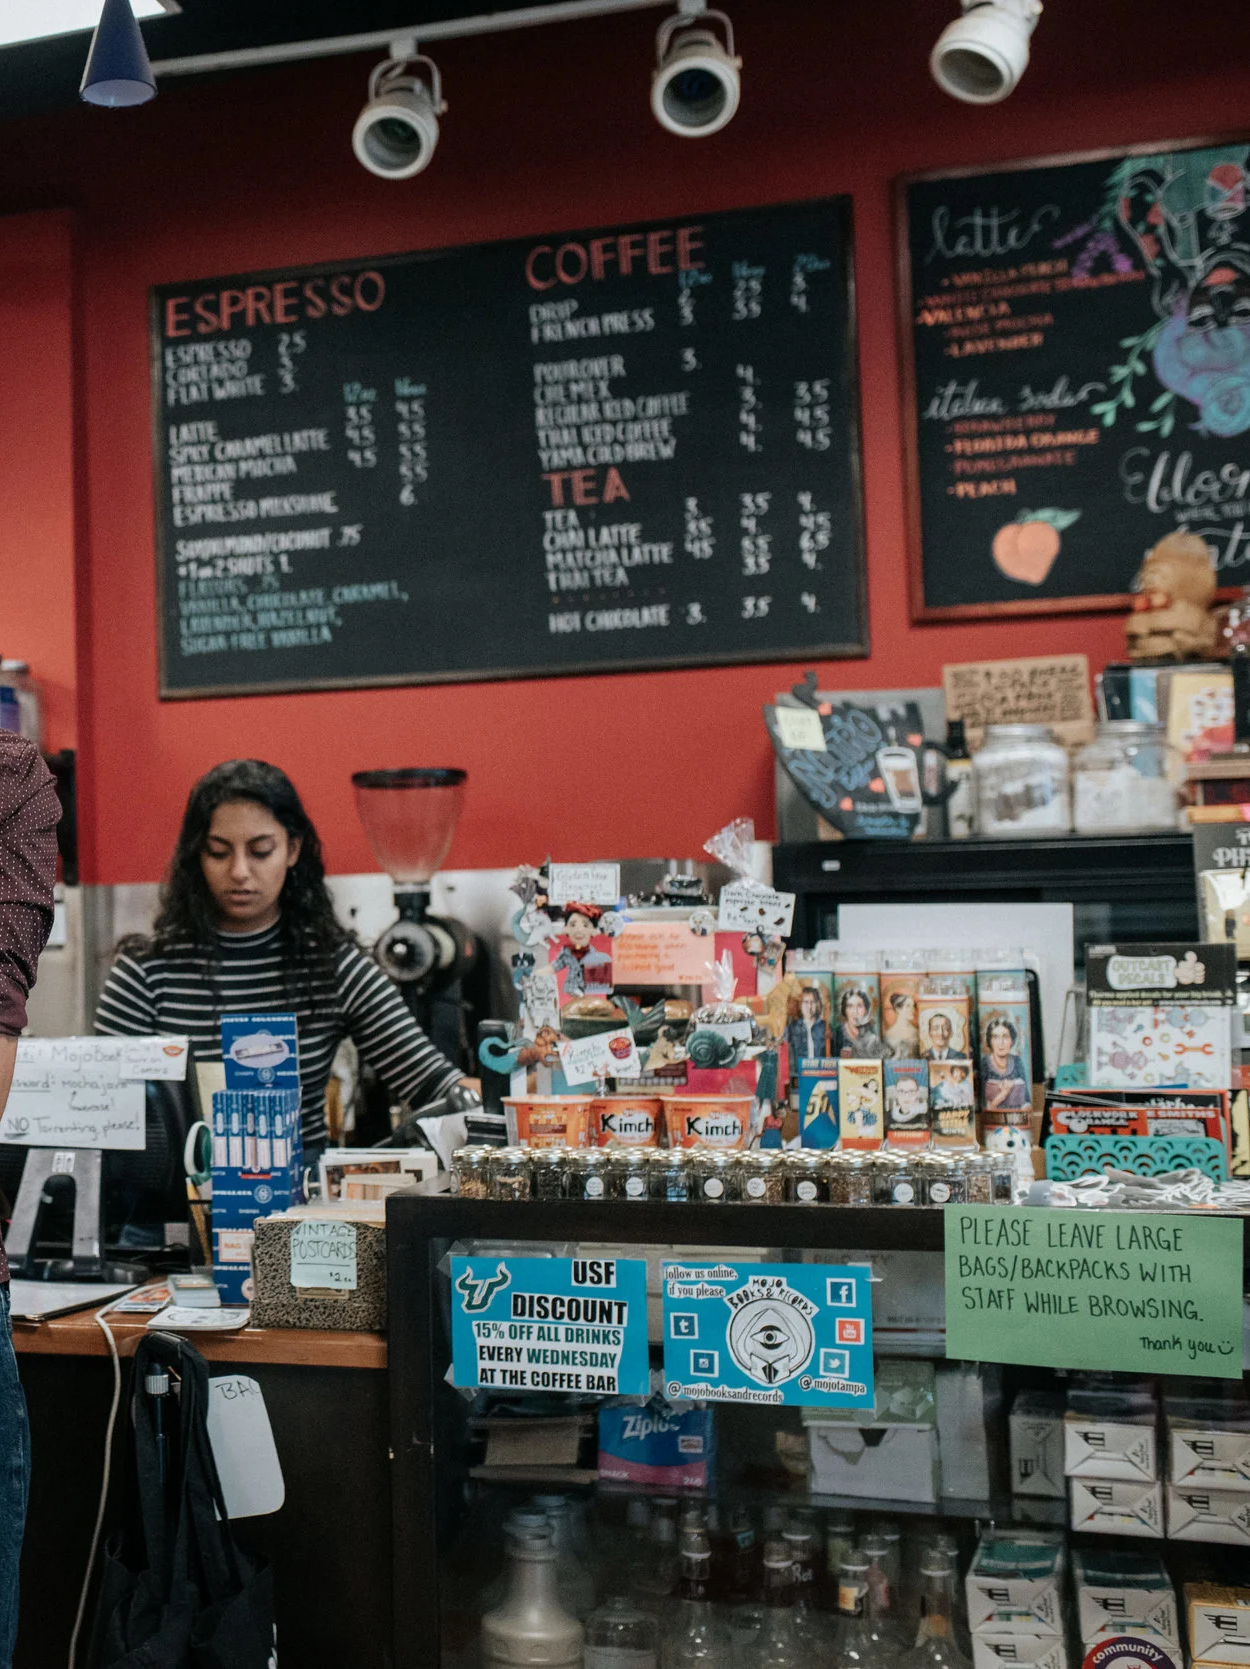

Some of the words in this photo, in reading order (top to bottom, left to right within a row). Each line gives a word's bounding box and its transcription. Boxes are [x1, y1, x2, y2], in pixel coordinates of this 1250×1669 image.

[525, 226, 706, 290] COFFEE
[165, 271, 386, 337] ESPRESSO
[542, 466, 631, 508] TEA
[1112, 960, 1170, 971] OUTCAST
[1118, 973, 1166, 985] DECALS
[7, 1118, 30, 1132] NO
[292, 1223, 355, 1237] VINTAGE
[960, 1216, 1033, 1247] PLEASE
[1047, 1223, 1106, 1249] LEAVE
[1117, 1224, 1183, 1252] LARGE
[292, 1238, 357, 1260] POSTCARDS
[573, 1260, 615, 1285] USF
[695, 1269, 706, 1279] us
[959, 1254, 1130, 1282] BAGS/BACKPACKS
[1139, 1262, 1192, 1283] WITH
[669, 1285, 675, 1297] if
[677, 1287, 693, 1298] you
[695, 1285, 724, 1298] please
[752, 1278, 783, 1288] MOJO
[512, 1293, 628, 1325] DISCOUNT
[961, 1286, 1015, 1311] STAFF
[1024, 1292, 1079, 1315] WHILE
[1089, 1295, 1204, 1322] BROWSING.
[474, 1322, 504, 1340] 15%
[508, 1323, 534, 1341] OFF
[536, 1325, 561, 1342] ALL
[564, 1327, 622, 1346] DRINKS
[479, 1345, 523, 1362] EVERY
[526, 1348, 617, 1369] WEDNESDAY
[1139, 1336, 1183, 1352] Thank
[1188, 1343, 1216, 1360] you
[479, 1369, 497, 1384] AT
[500, 1369, 526, 1386] THE
[530, 1372, 582, 1389] COFFEE
[586, 1374, 617, 1392] BAR
[1092, 1643, 1164, 1665] community
